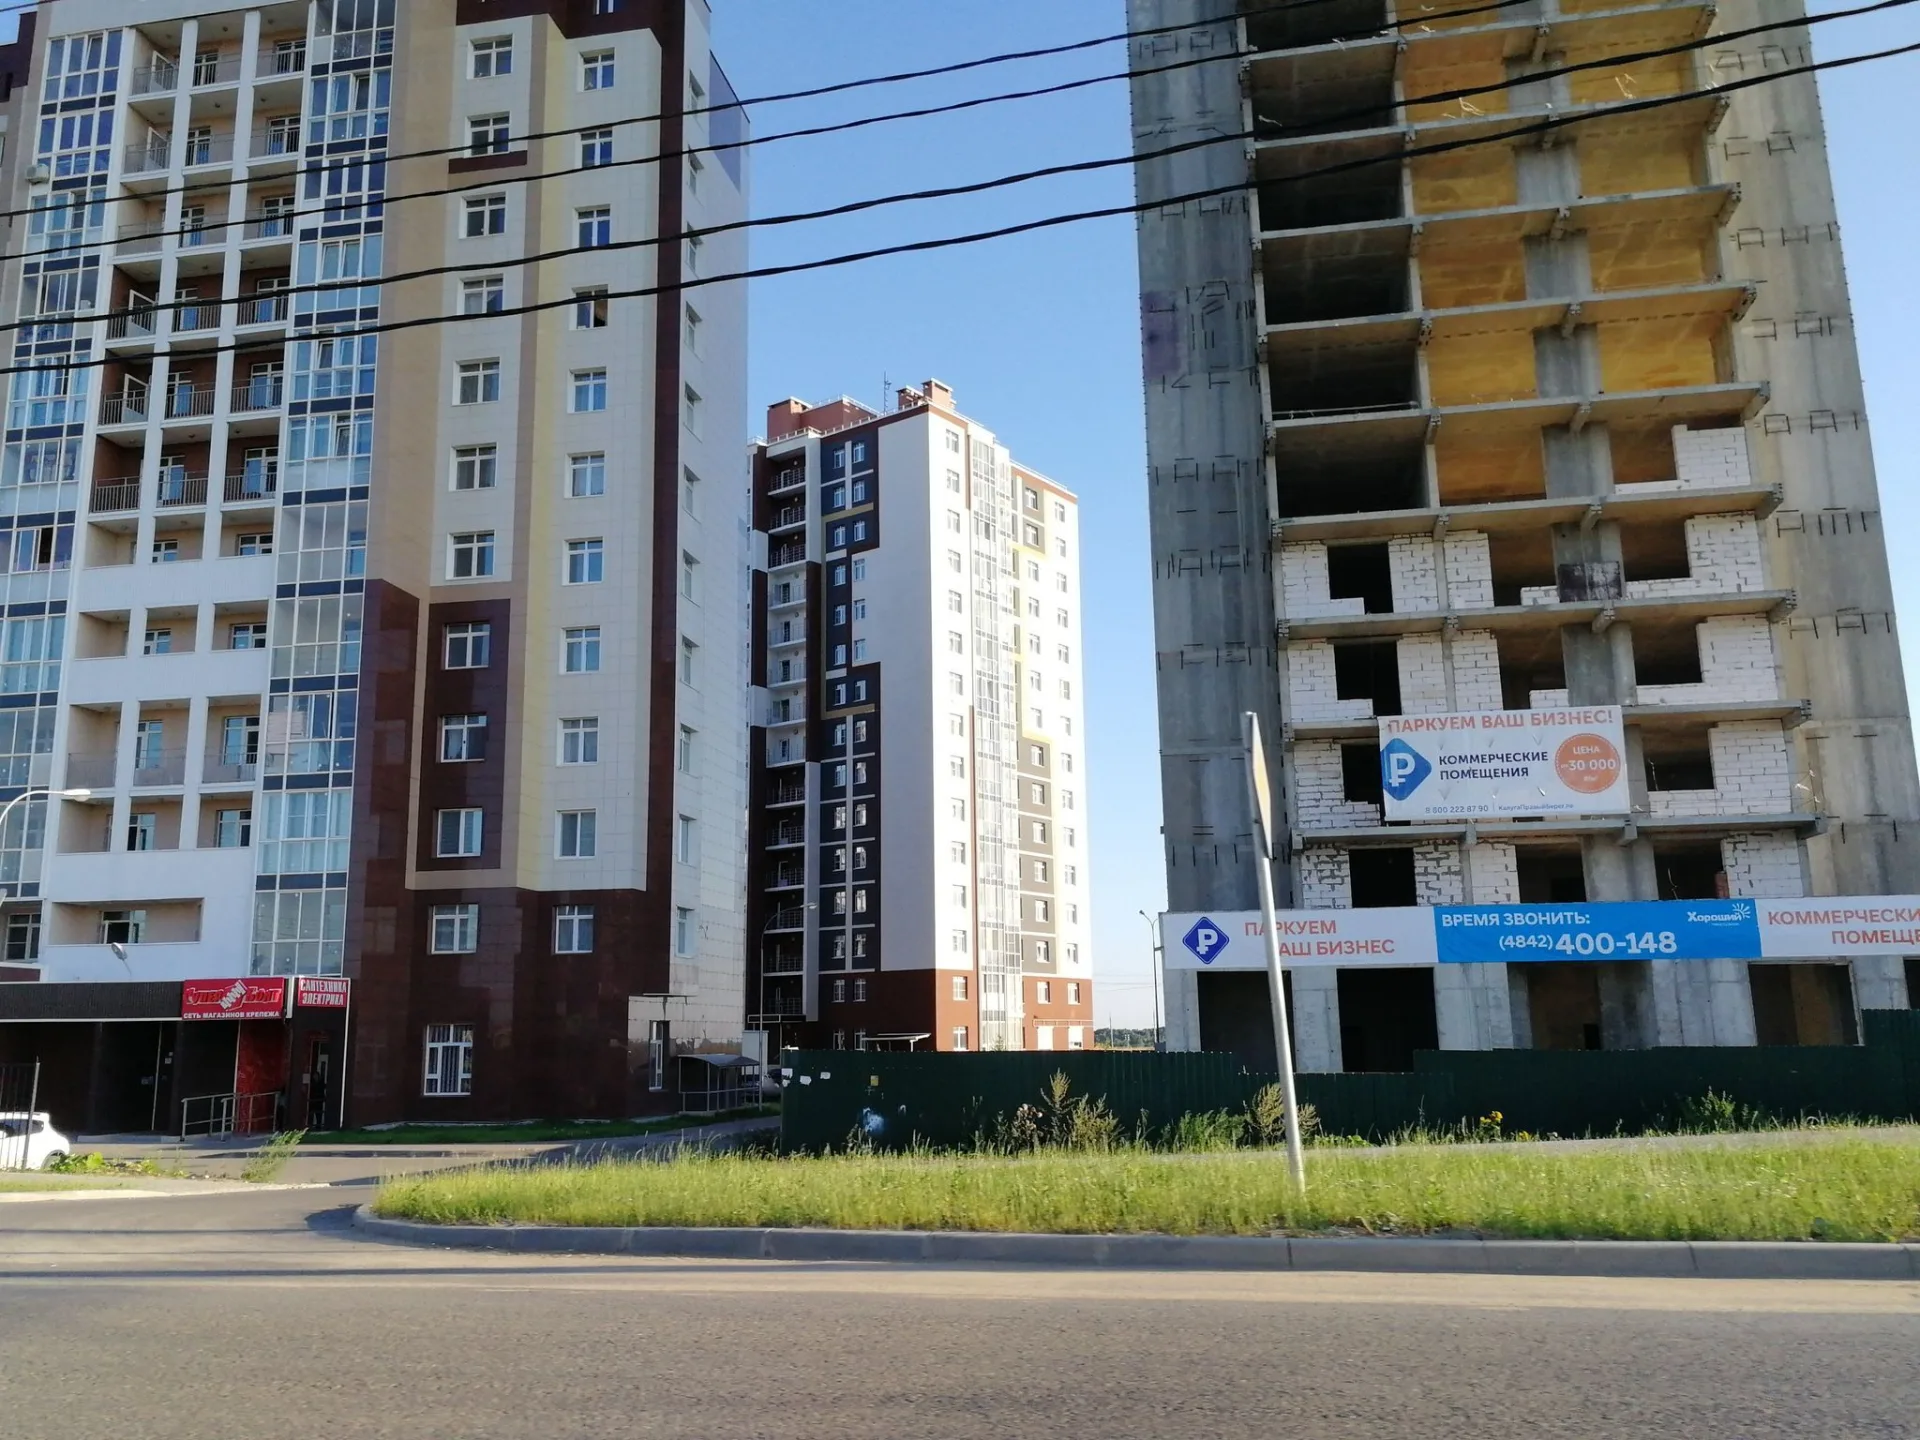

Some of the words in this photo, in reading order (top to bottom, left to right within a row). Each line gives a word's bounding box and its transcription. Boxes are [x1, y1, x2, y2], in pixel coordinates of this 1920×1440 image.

[1388, 715, 1476, 733] ПАРКУЕМ
[1481, 712, 1524, 729] ВАШ
[1531, 710, 1614, 727] БИЗНЕС!
[1573, 745, 1600, 755] ЦЕНА
[1439, 751, 1548, 766] КОММЕРЧЕСКИЕ
[1589, 758, 1616, 770] 000
[1440, 767, 1529, 781] ПОМЕЩЕНИЯ
[1450, 805, 1465, 813] 222
[1442, 913, 1499, 927] ВРЕМЯ
[1503, 911, 1590, 926] ЗВОНИТЬ:
[1687, 911, 1742, 923] Хороший
[1279, 941, 1312, 956] АШ
[1316, 939, 1395, 956] БИЗНЕС
[1499, 934, 1553, 951] (4842)
[1555, 931, 1677, 955] 400-148
[301, 979, 346, 993] САНТЕХНИКА
[302, 993, 344, 1006] ЭЛЕКТРИКА
[203, 1011, 245, 1019] МАГАЗИНОВ
